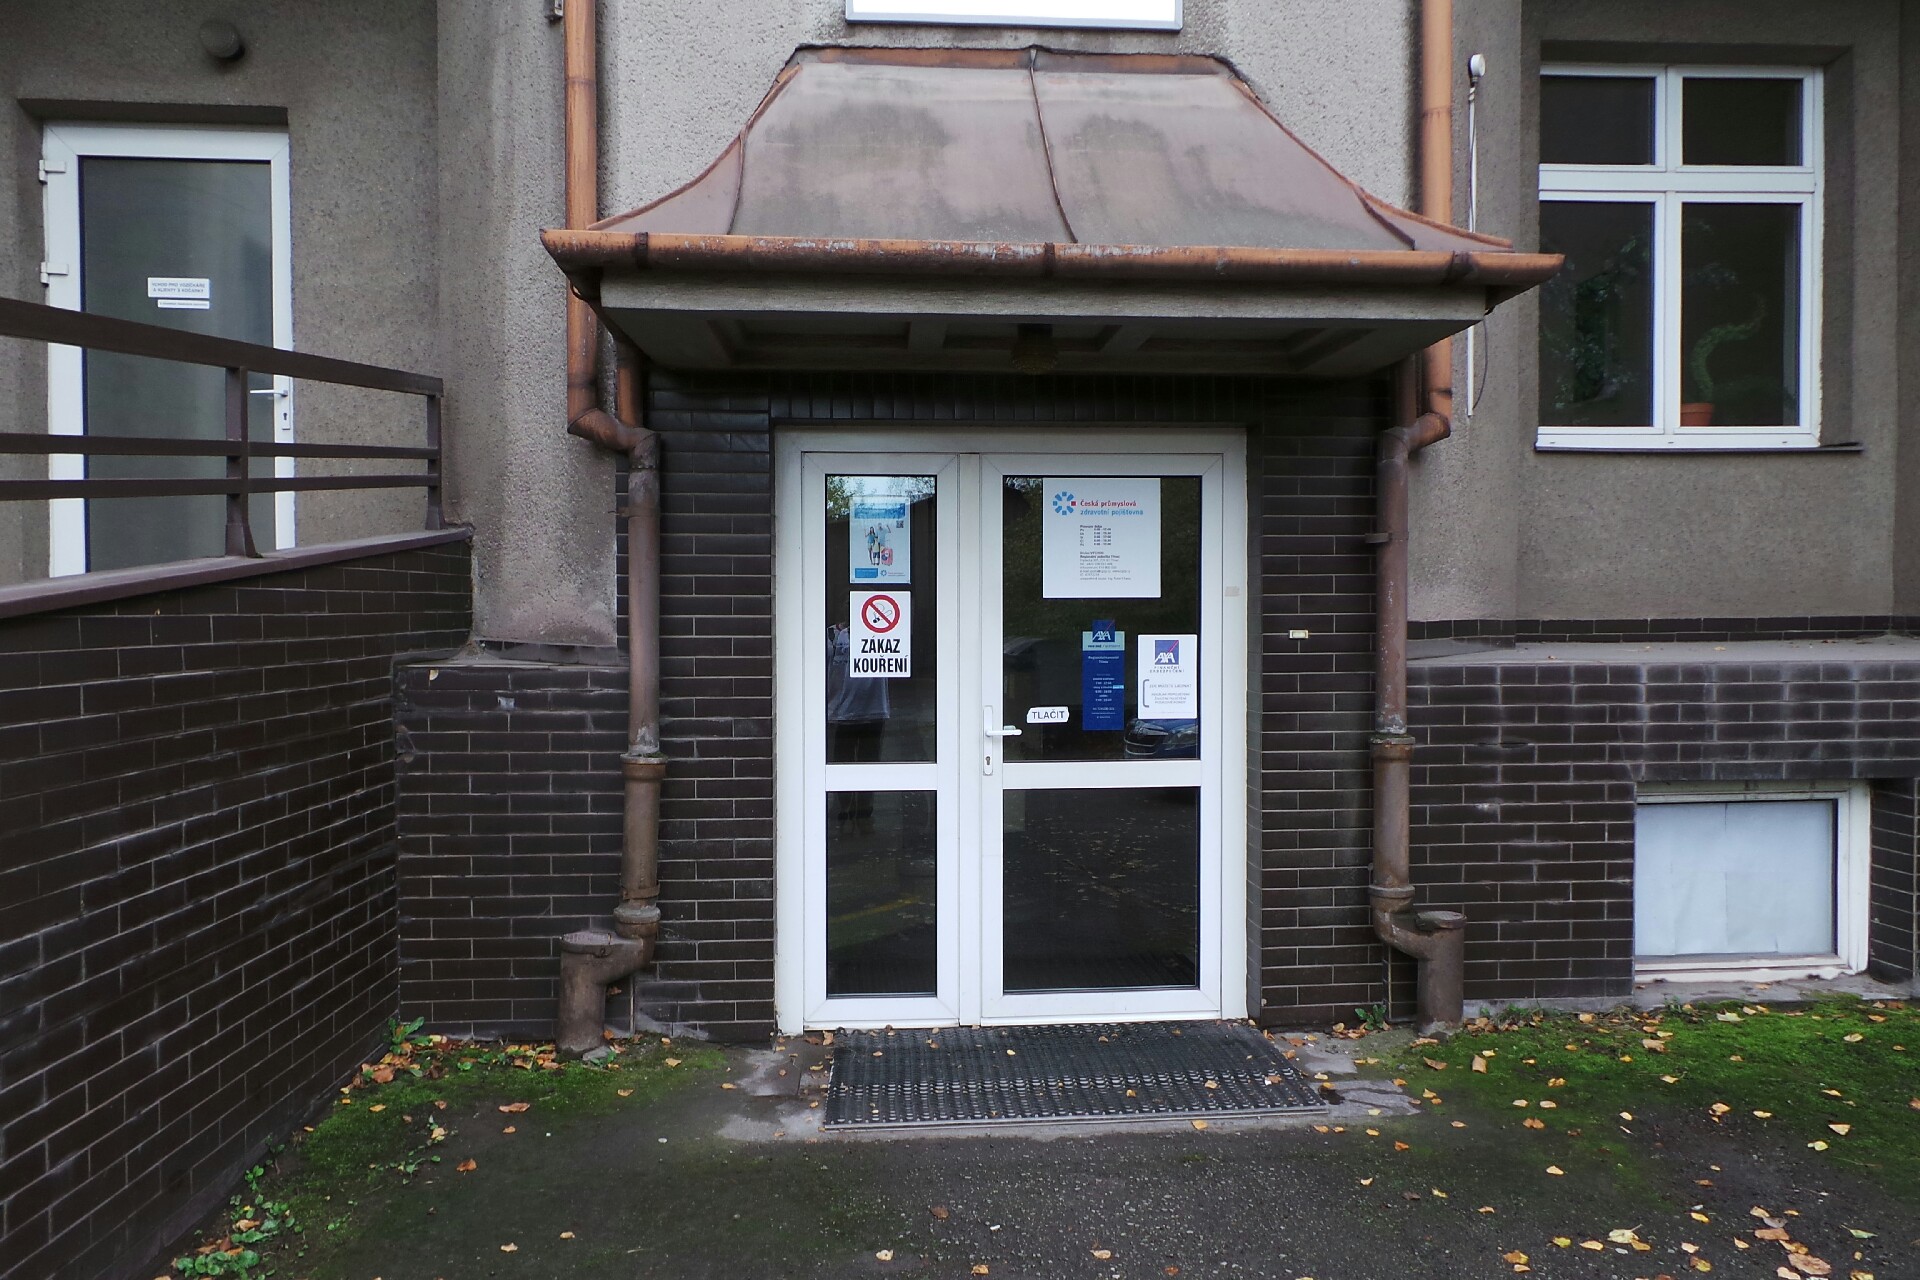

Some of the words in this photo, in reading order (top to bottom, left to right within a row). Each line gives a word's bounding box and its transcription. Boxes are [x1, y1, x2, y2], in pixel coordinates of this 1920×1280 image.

[1080, 499, 1098, 507] Česká
[1101, 500, 1136, 508] průmyslová
[1092, 631, 1111, 640] AXA
[861, 636, 900, 653] ZÁKAZ
[1154, 652, 1176, 663] AXA
[854, 655, 908, 673] KOUŘENÍ
[1032, 709, 1065, 719] TLAČIT
